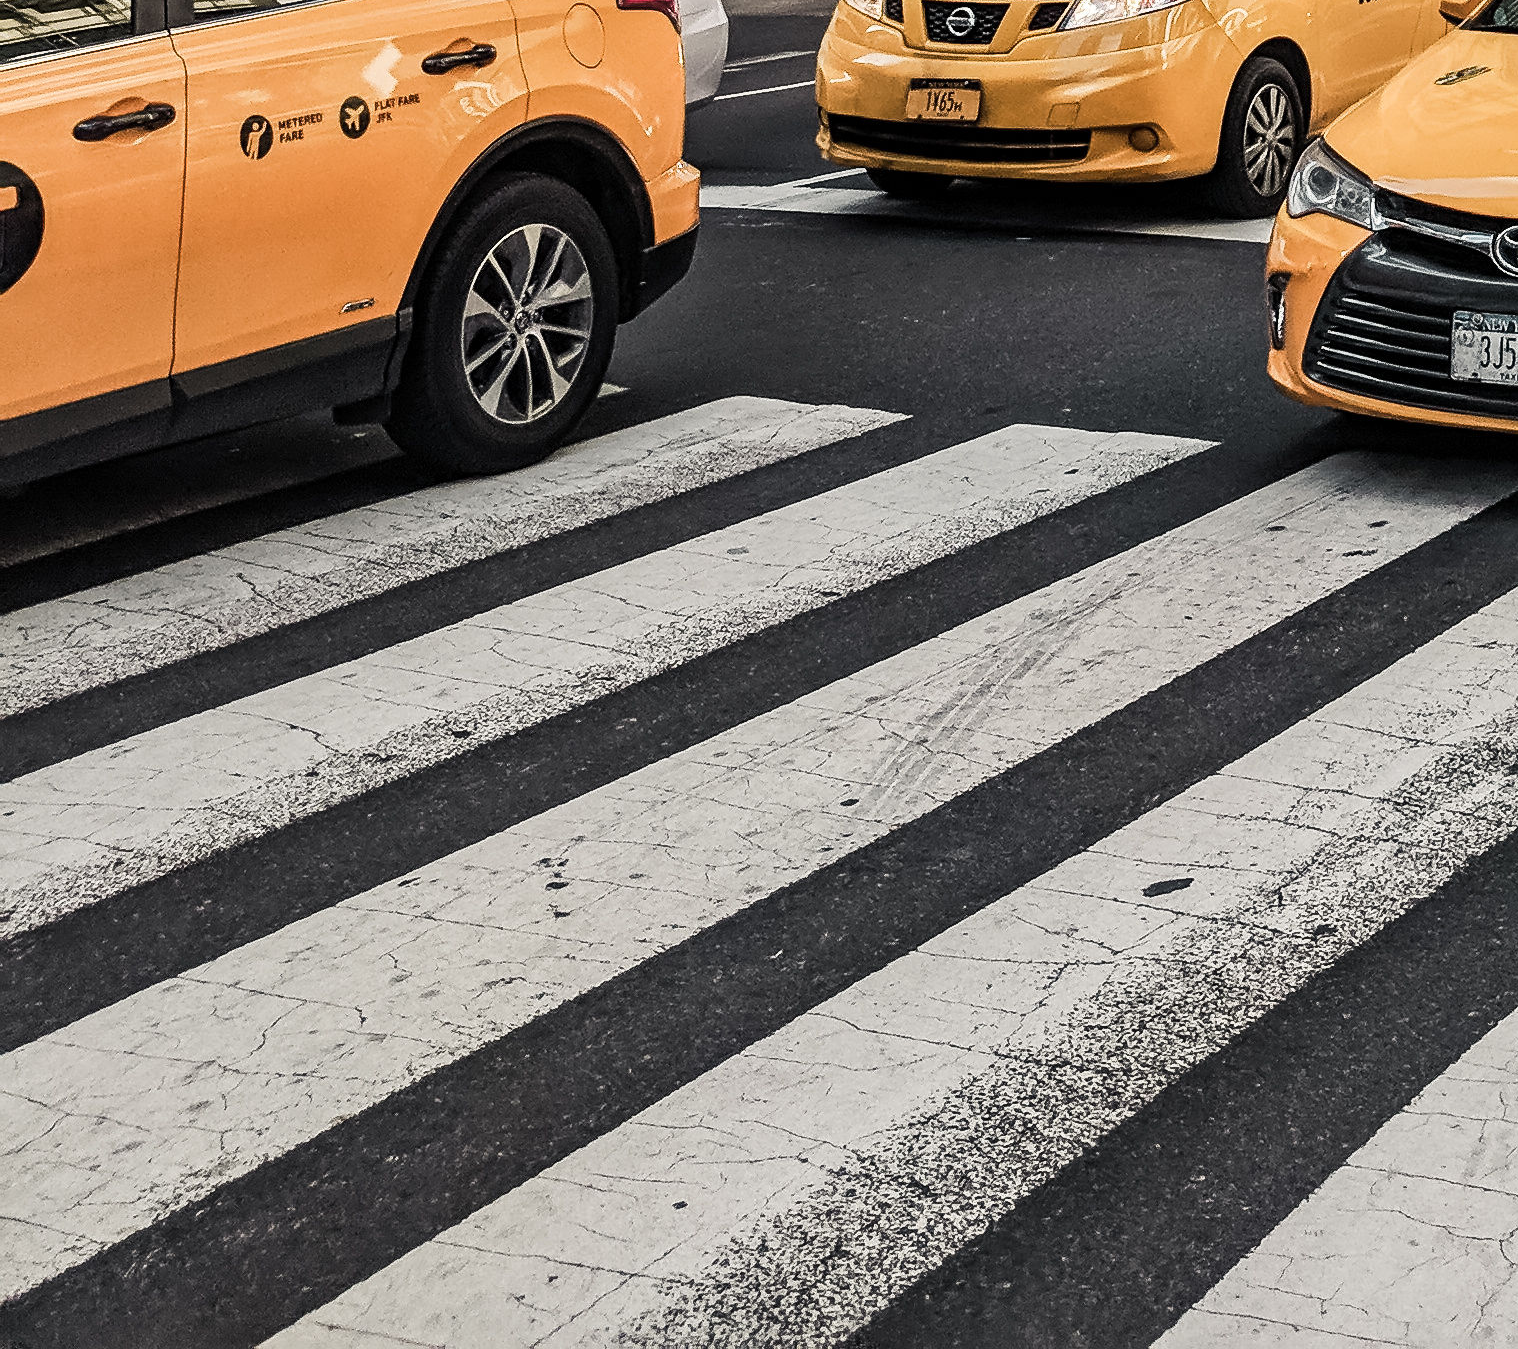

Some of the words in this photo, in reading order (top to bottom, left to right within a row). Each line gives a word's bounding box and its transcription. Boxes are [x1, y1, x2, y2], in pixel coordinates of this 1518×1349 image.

[374, 98, 396, 111] FLAT
[398, 93, 421, 107] FARE
[278, 112, 323, 131] METERED
[376, 111, 393, 124] JFK
[279, 128, 305, 144] FARE
[1481, 319, 1510, 332] NEW
